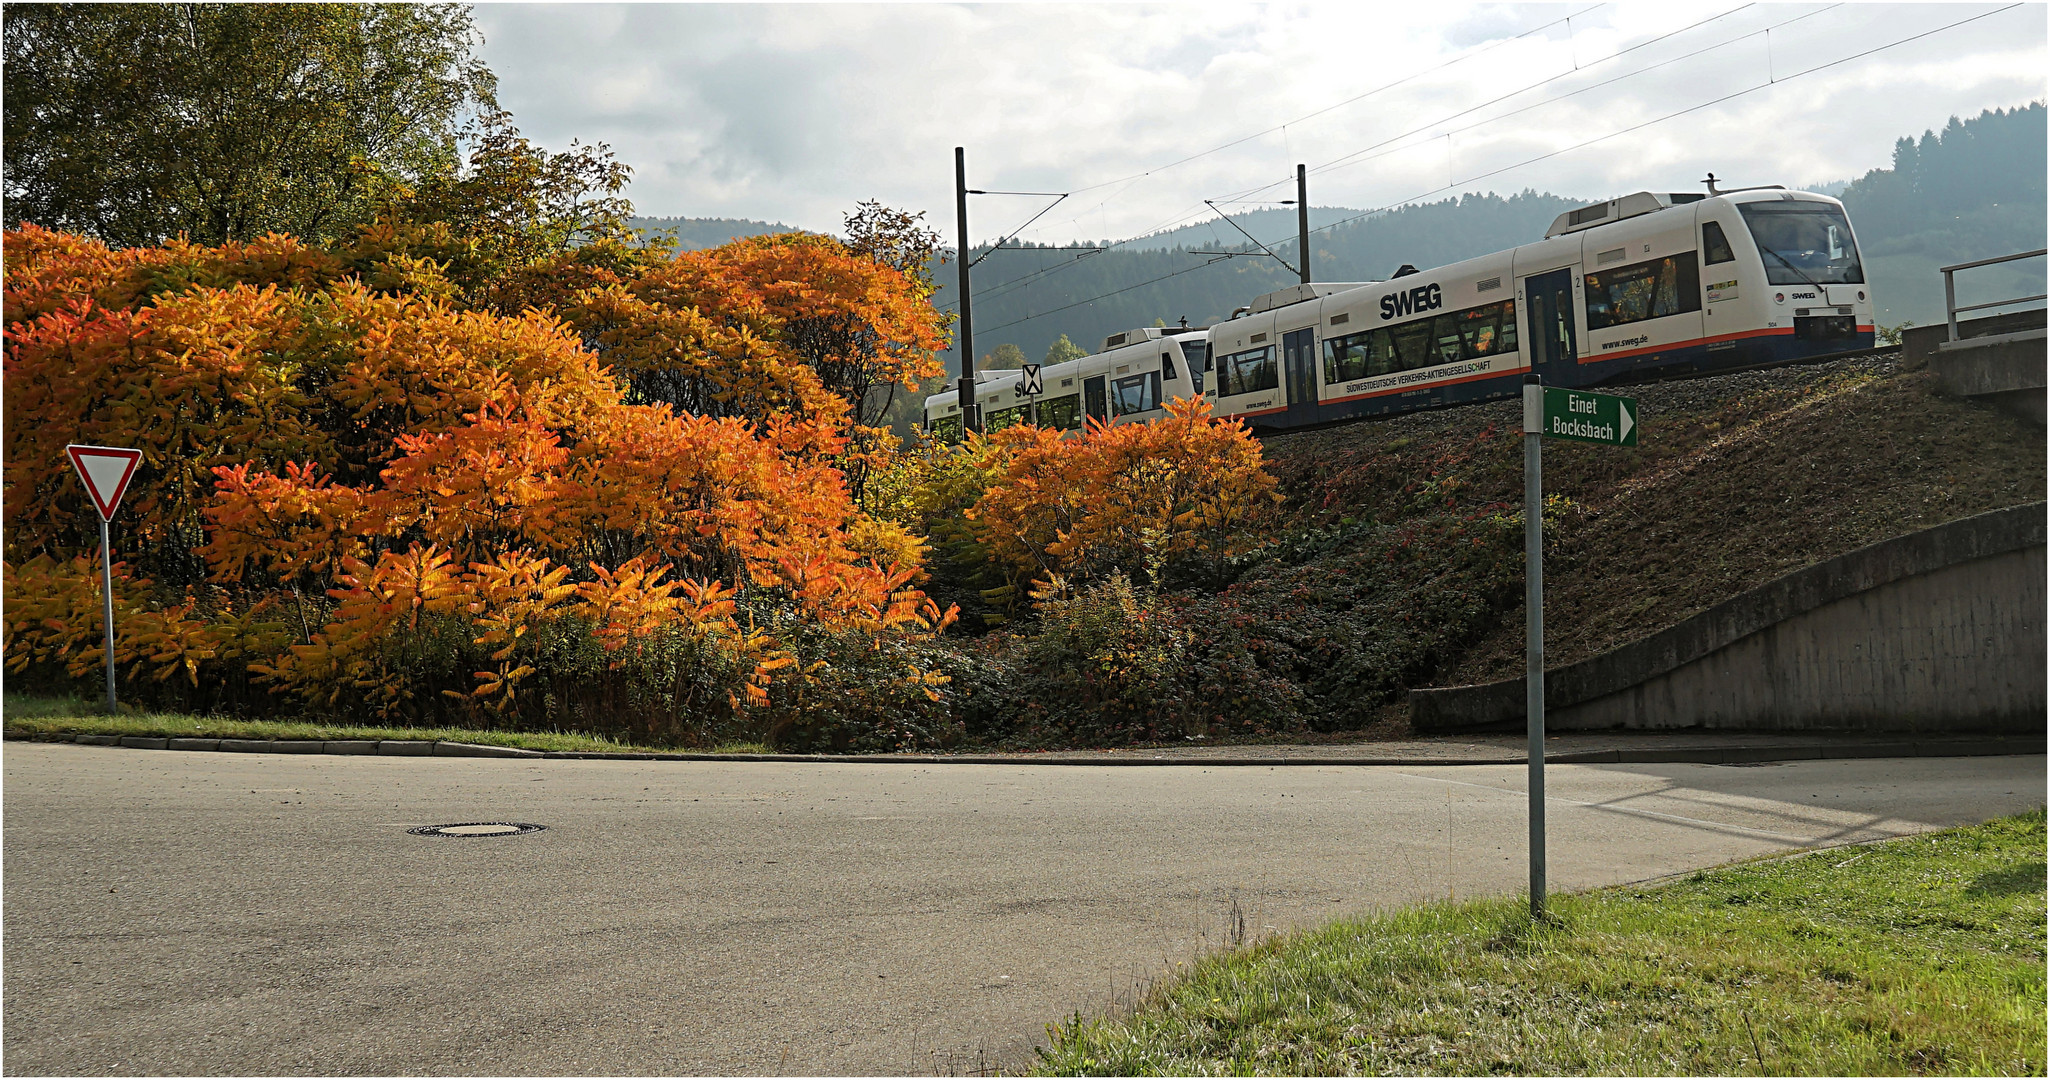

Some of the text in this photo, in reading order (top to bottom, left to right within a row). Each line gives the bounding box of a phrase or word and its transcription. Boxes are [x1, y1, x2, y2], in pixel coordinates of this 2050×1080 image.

[1575, 277, 1580, 288] 2
[1380, 282, 1442, 320] SWEG
[1518, 290, 1523, 300] 2
[1791, 292, 1815, 300] SWEG
[1602, 334, 1648, 349] www.sweg.de
[1346, 361, 1491, 393] SÜDWESTDEUTSCHE VERKEHRS-AKTIENGESELLSCHAFT
[1568, 394, 1597, 415] Einet
[1553, 416, 1613, 440] Bocksbach
